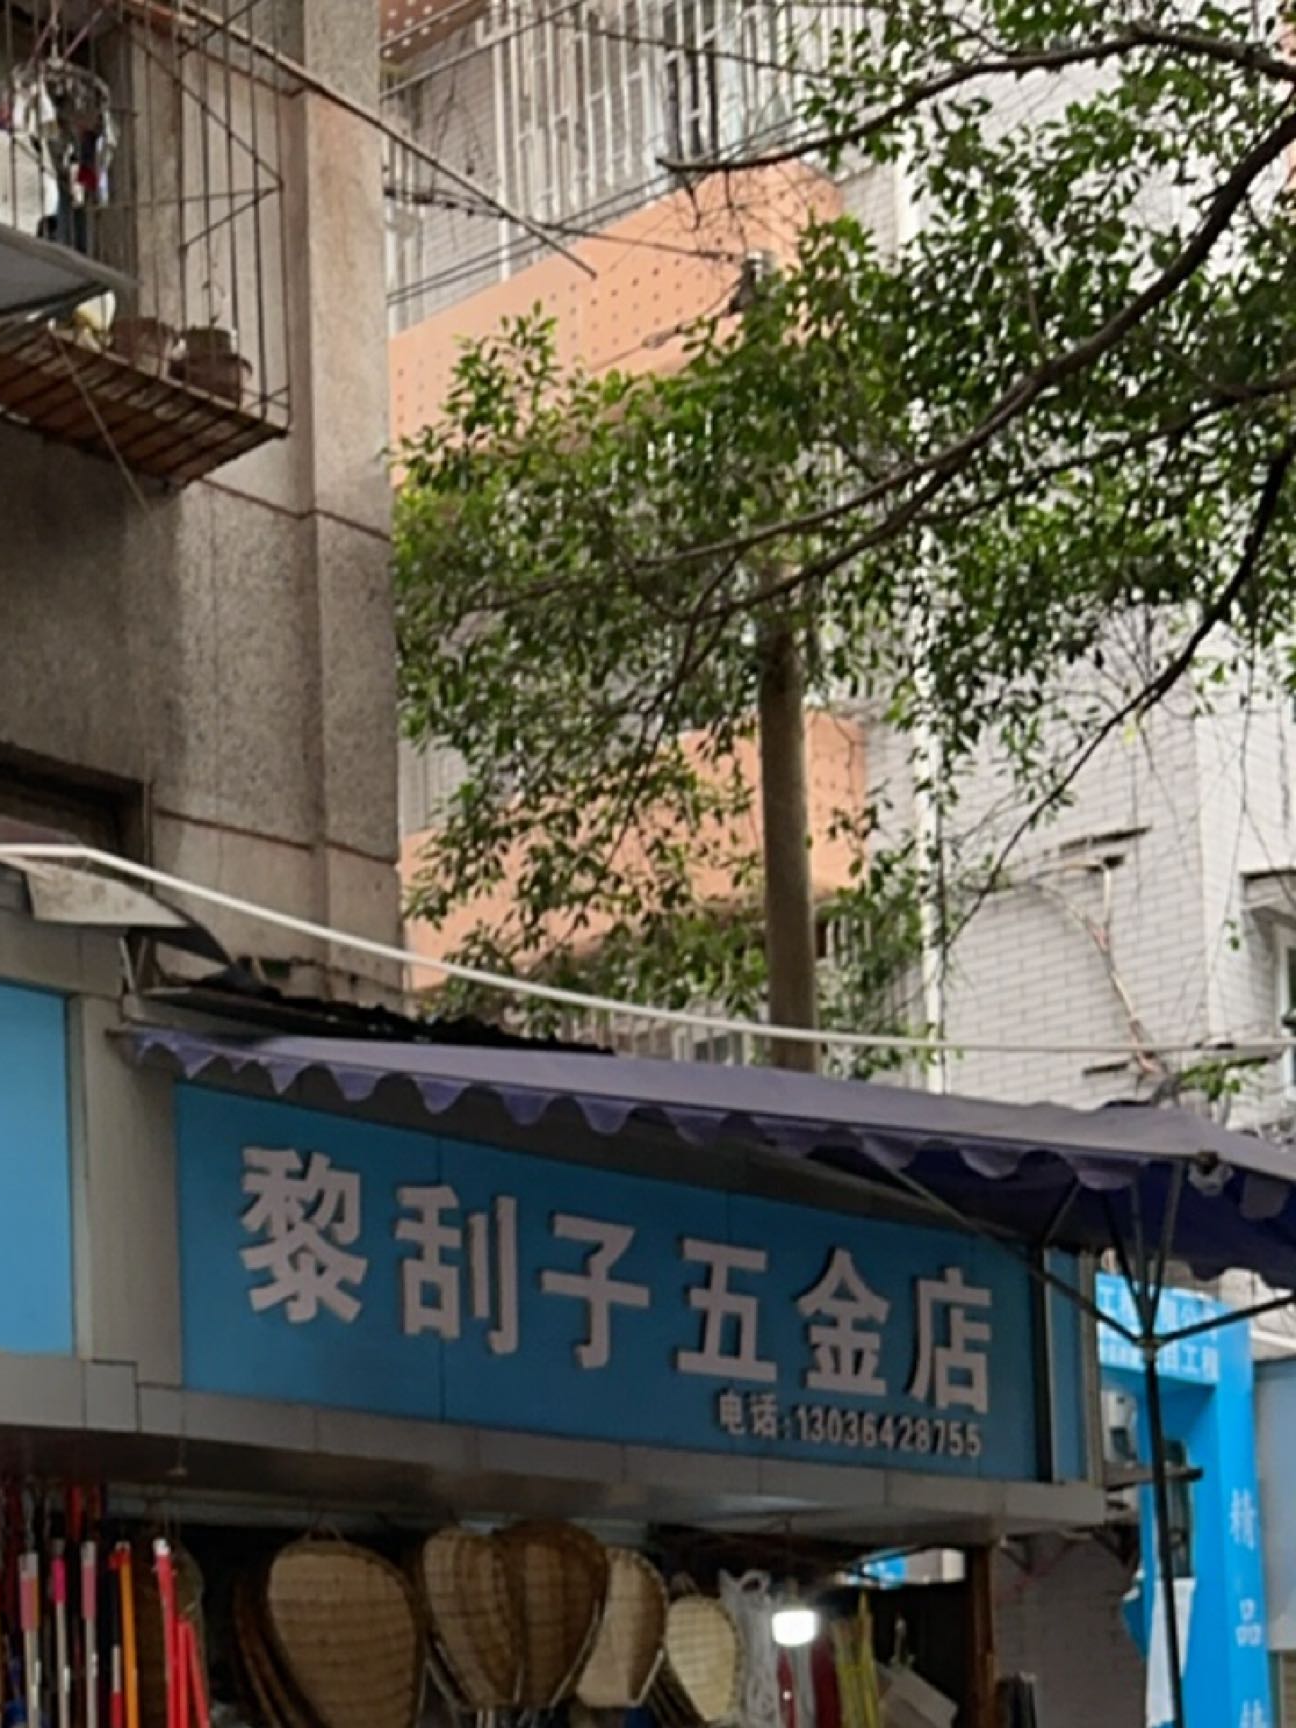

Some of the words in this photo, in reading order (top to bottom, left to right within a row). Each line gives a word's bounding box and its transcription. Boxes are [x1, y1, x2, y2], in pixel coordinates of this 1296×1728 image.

[239, 1147, 993, 1414] 黎刮子五金店
